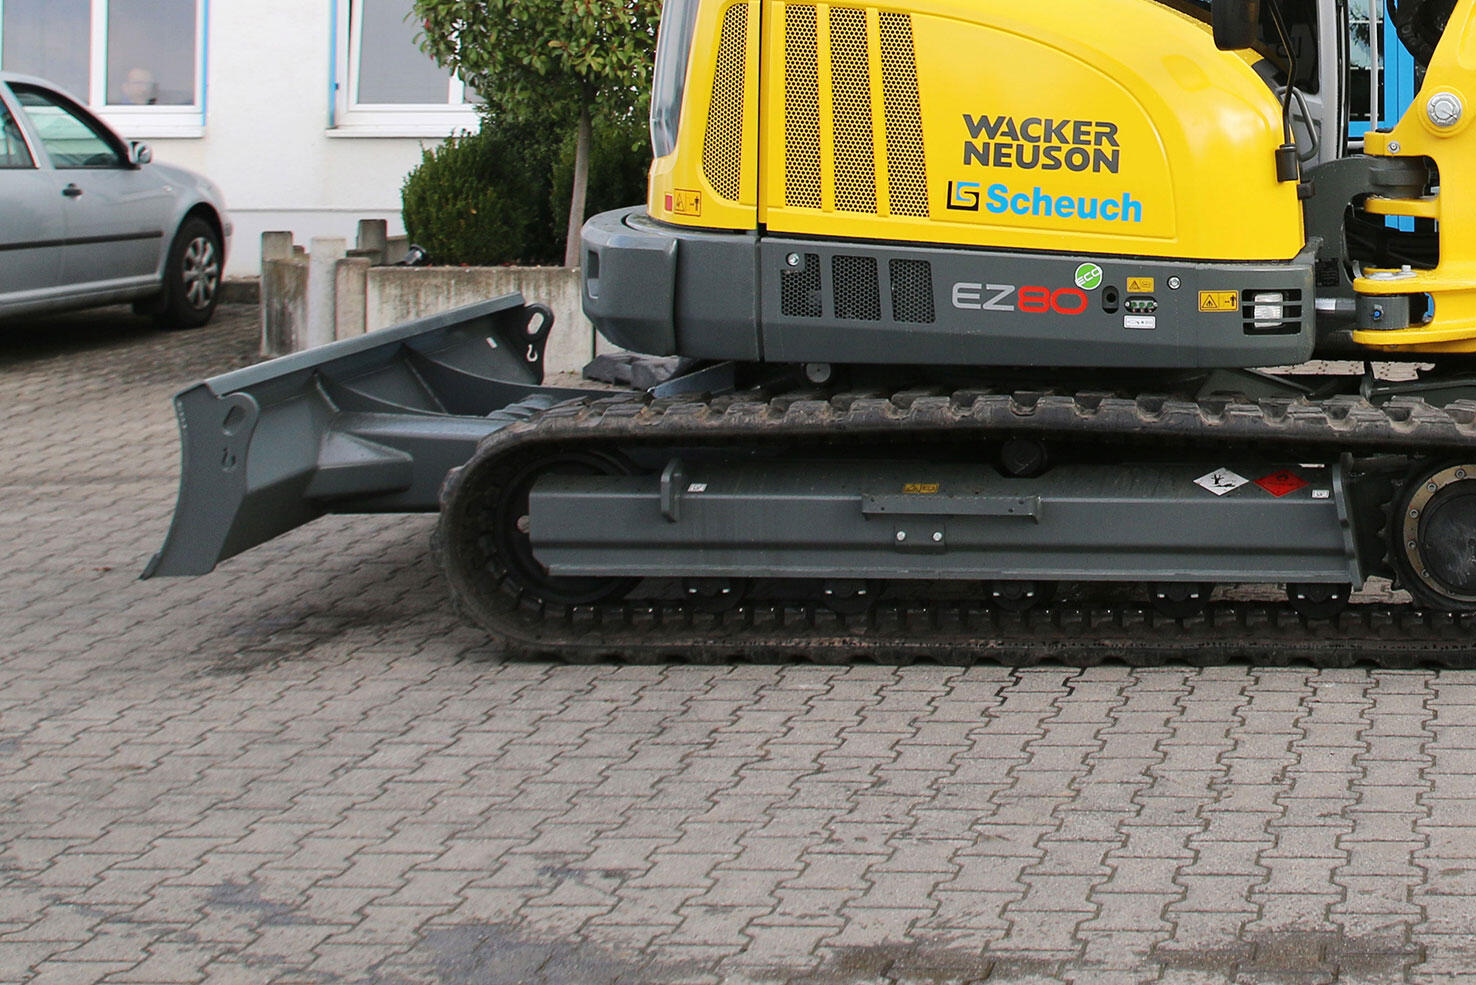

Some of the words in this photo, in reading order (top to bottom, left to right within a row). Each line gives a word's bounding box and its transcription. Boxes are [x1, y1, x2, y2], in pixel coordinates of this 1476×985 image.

[963, 114, 1120, 146] WACKER
[963, 142, 1120, 174] NEUSON
[985, 183, 1143, 223] Scheuch
[951, 282, 1089, 315] EZ80
